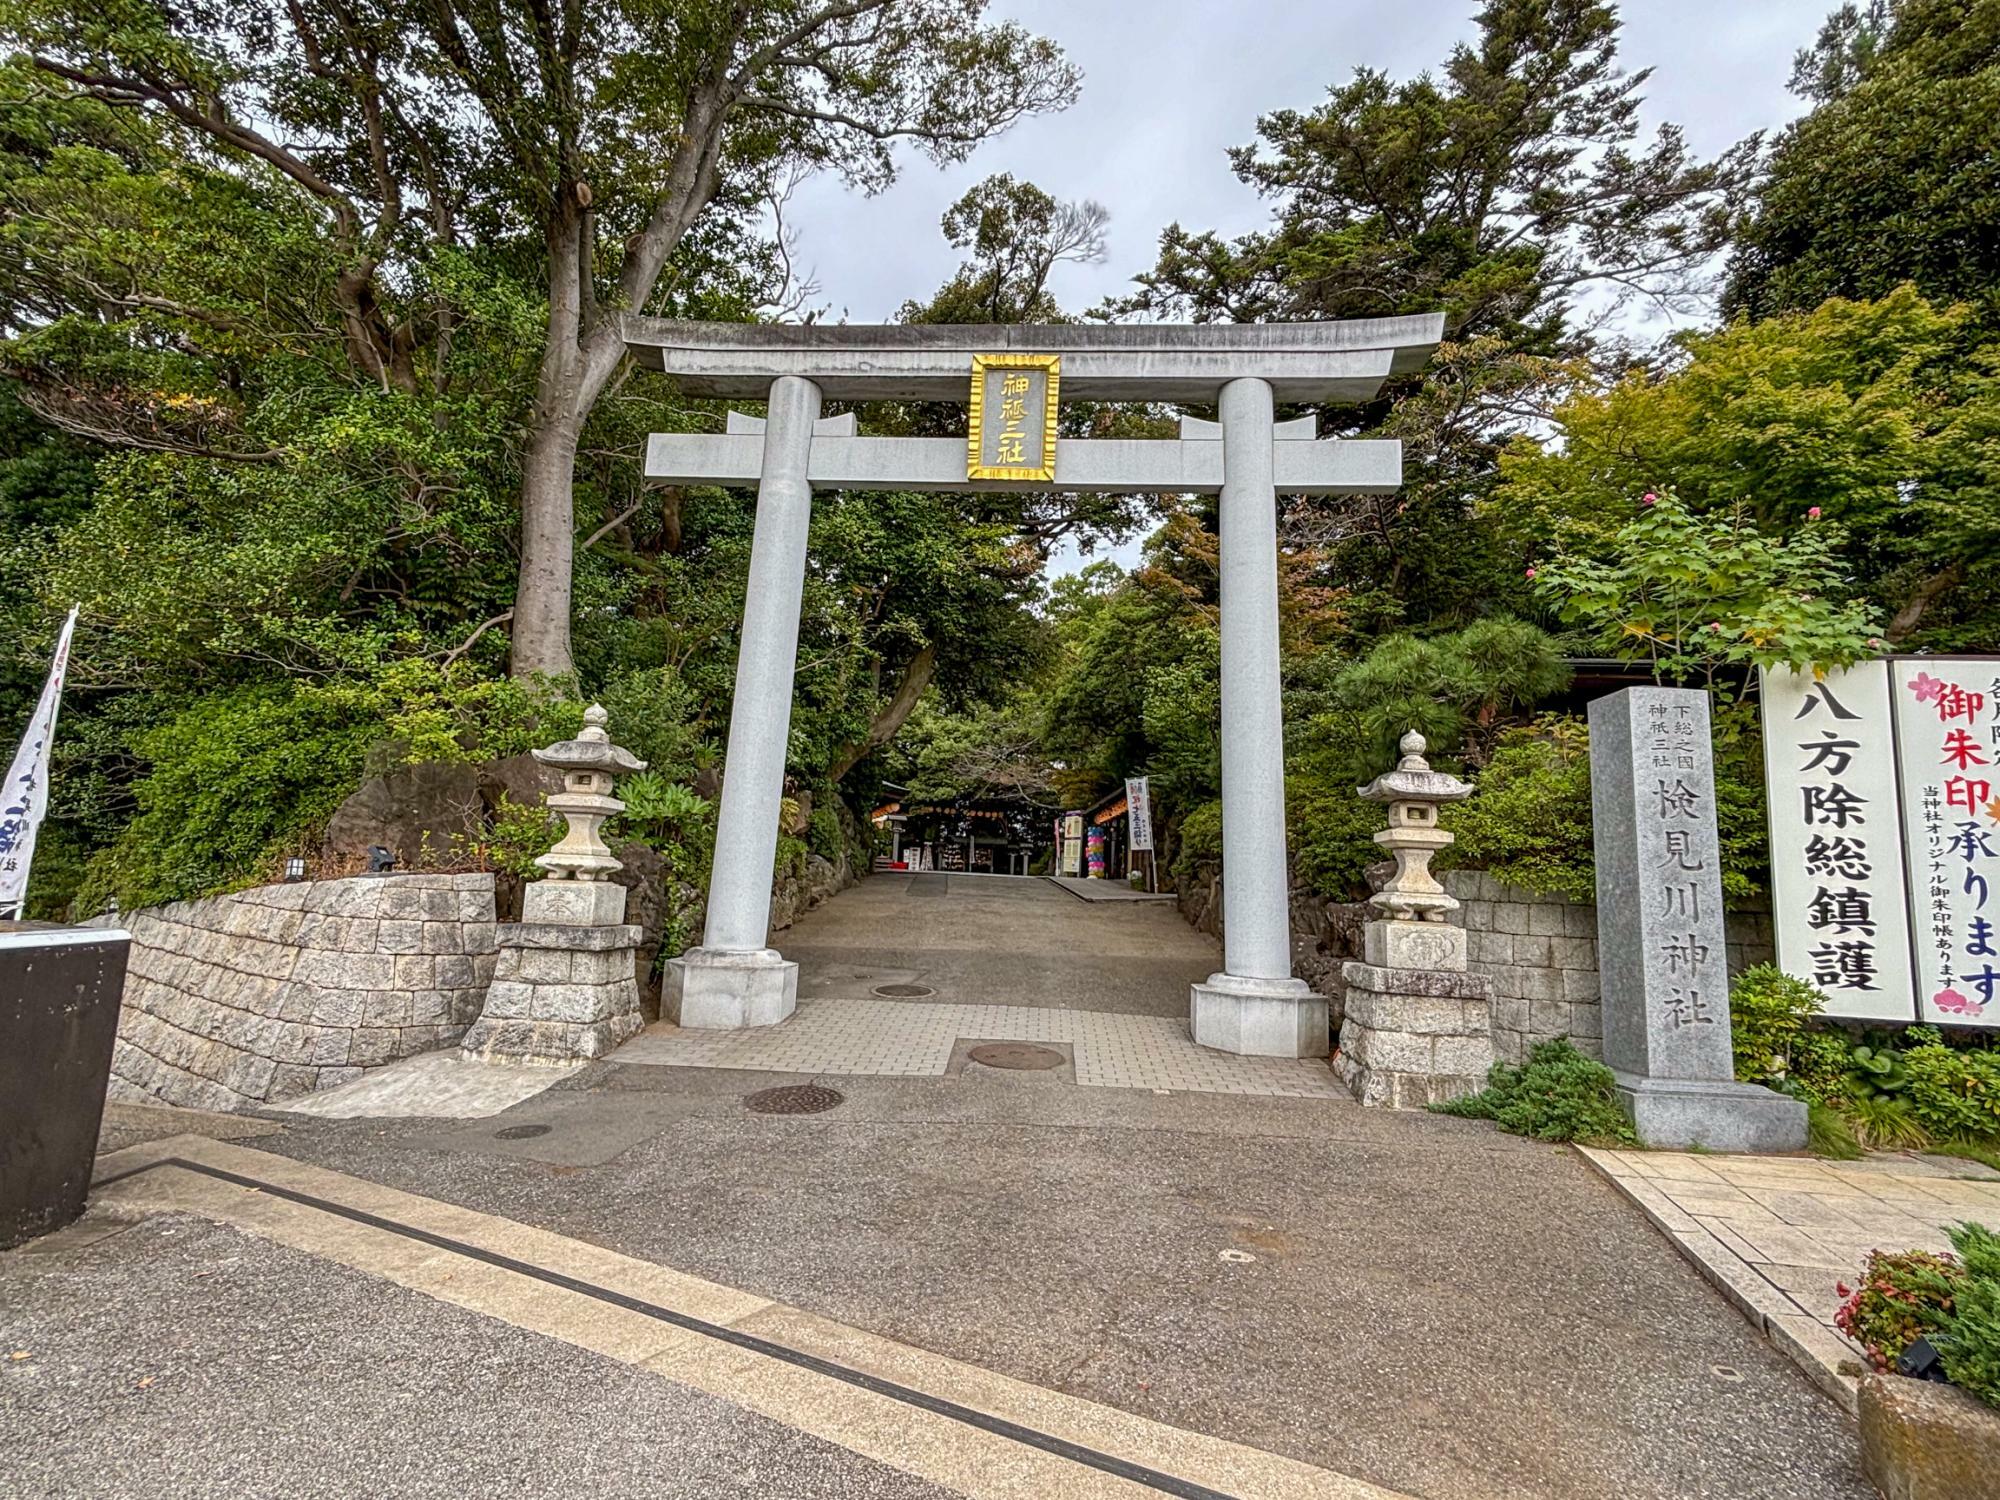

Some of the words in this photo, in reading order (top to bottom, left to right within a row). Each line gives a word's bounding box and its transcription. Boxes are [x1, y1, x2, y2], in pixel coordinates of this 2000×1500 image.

[1652, 779, 1714, 1030] 検見川神社
[1794, 681, 1883, 991] 八方除総鎮護
[1922, 786, 1957, 989] 当神社オリジナル御朱印帳あります
[1933, 683, 2000, 1006] 御朱印承ります
